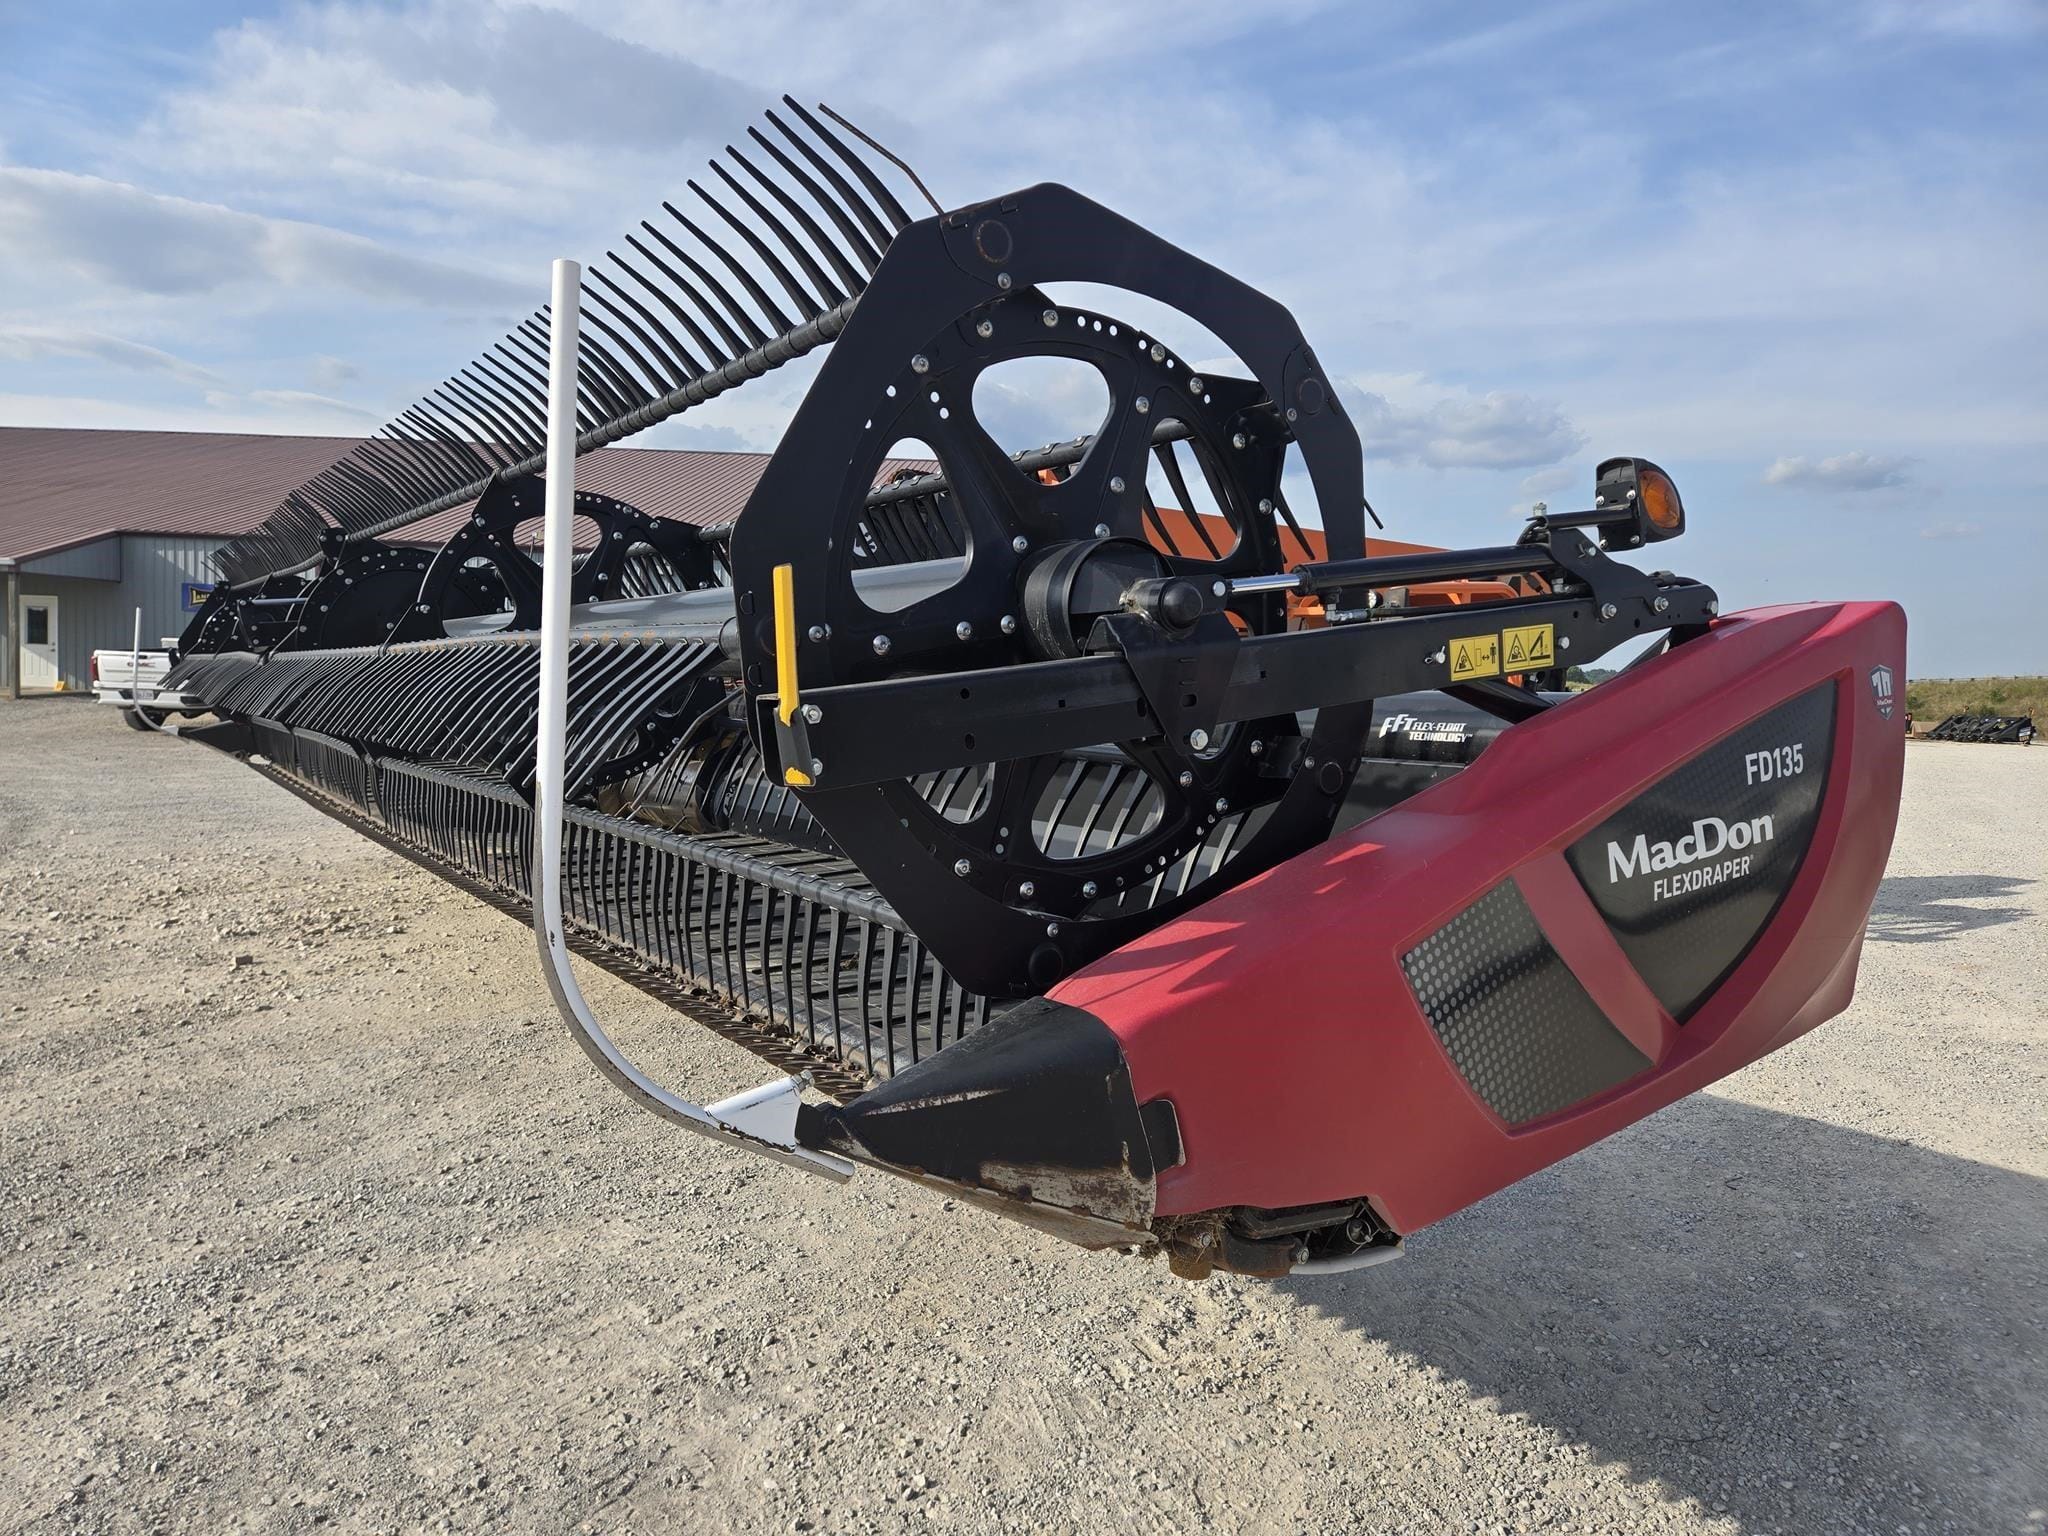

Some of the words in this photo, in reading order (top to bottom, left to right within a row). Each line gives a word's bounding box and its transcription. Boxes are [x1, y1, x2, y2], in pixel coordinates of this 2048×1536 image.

[1379, 713, 1418, 738] FFT
[1745, 743, 1804, 785] FD135
[1607, 814, 1774, 884] MacDon
[1653, 855, 1752, 902] FLEXDRAPER
